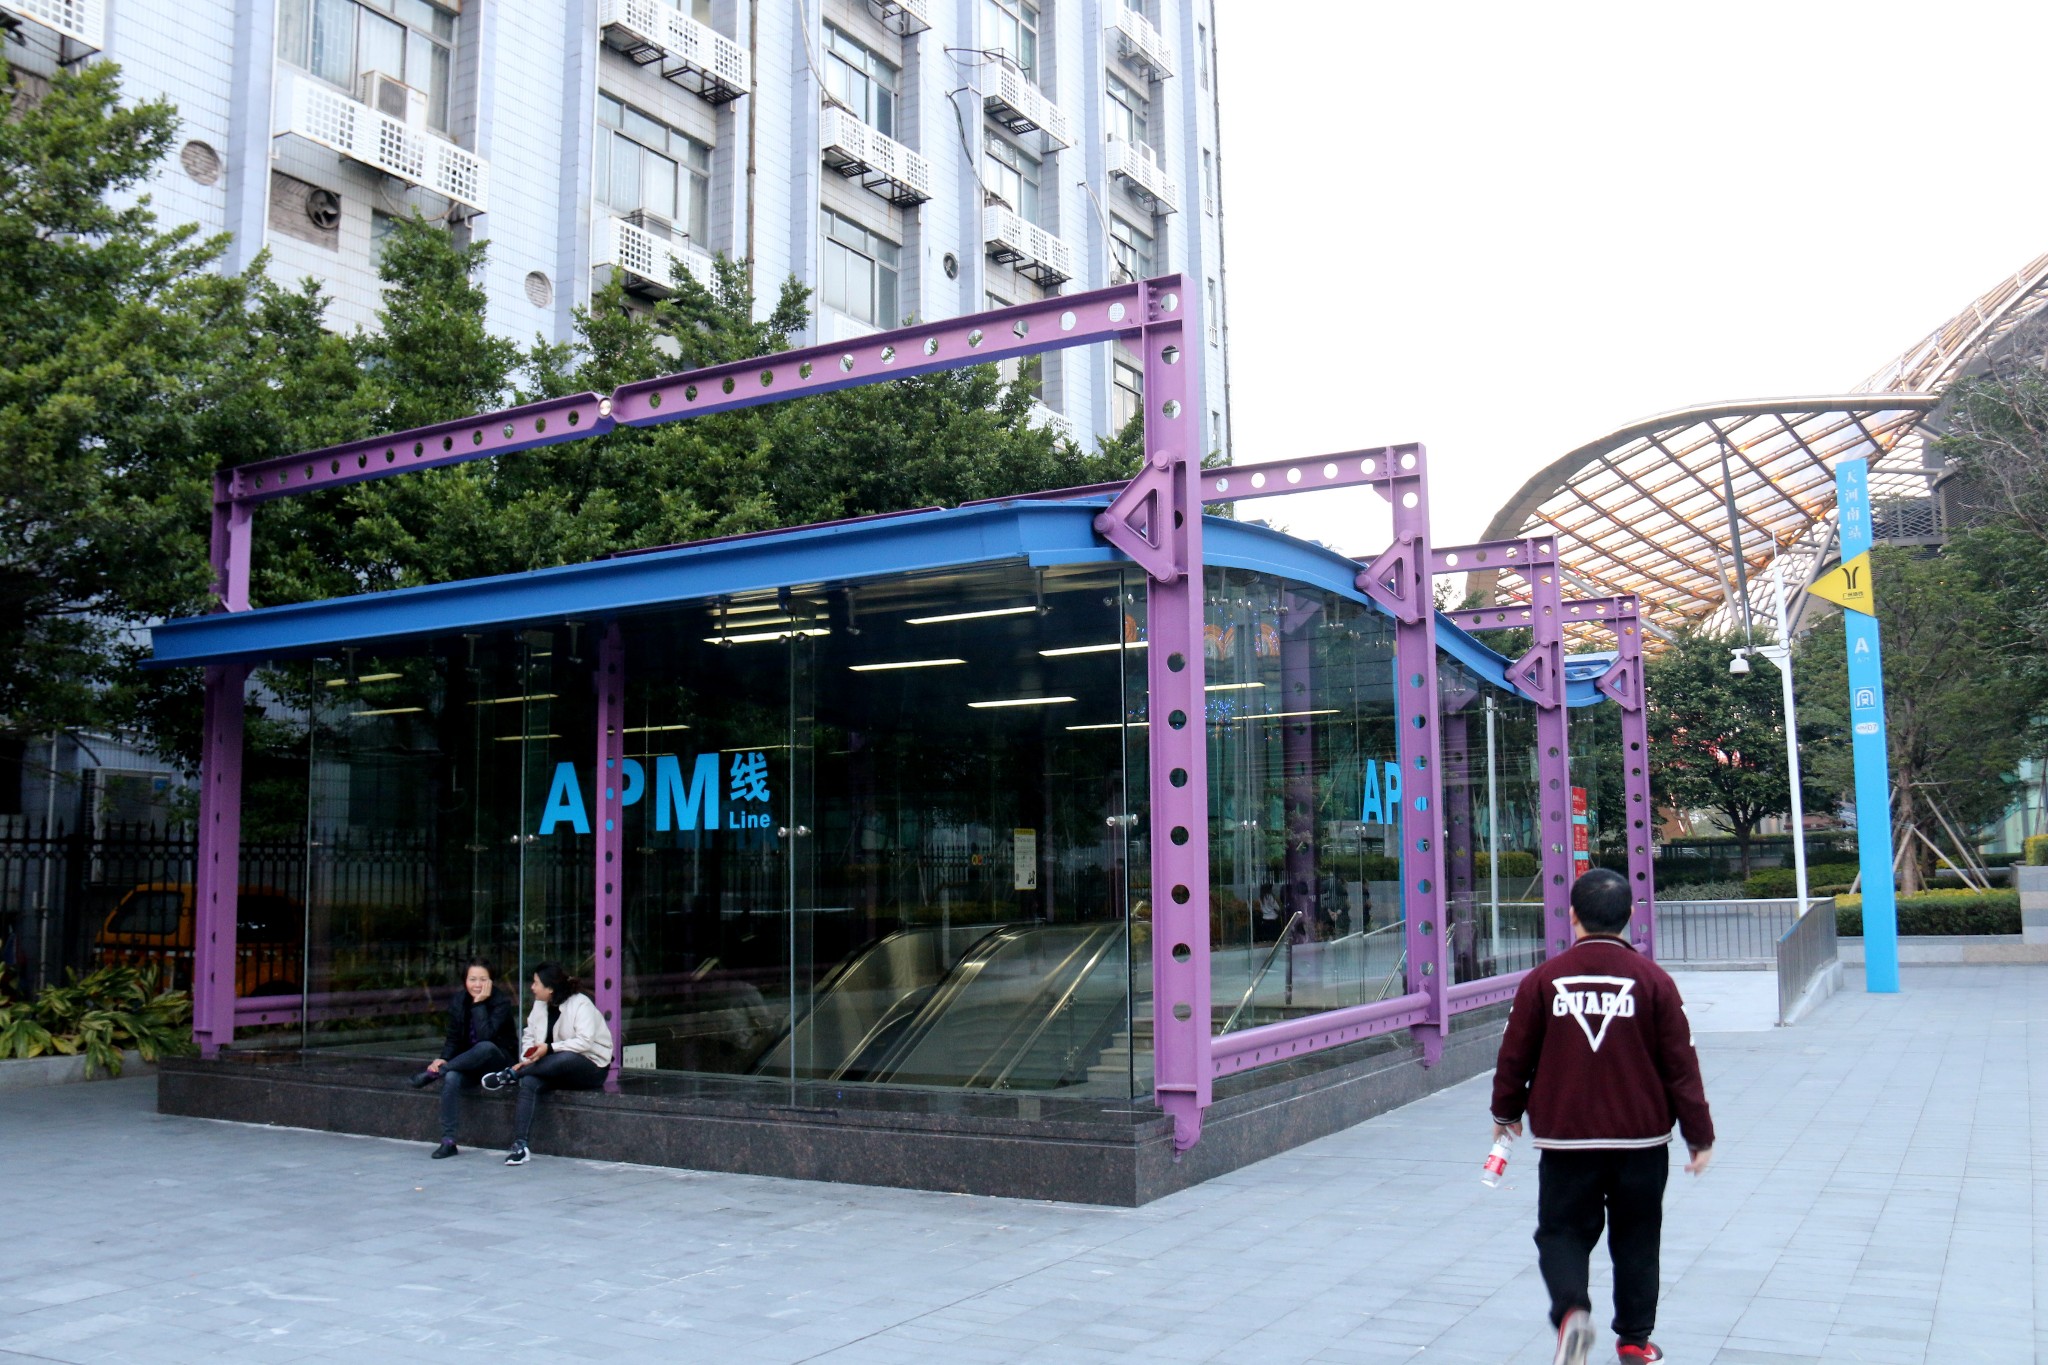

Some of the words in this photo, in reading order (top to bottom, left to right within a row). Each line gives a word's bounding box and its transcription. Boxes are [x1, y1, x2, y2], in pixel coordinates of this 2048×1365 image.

[1855, 637, 1870, 654] A
[730, 752, 770, 803] 线
[729, 810, 771, 829] Line
